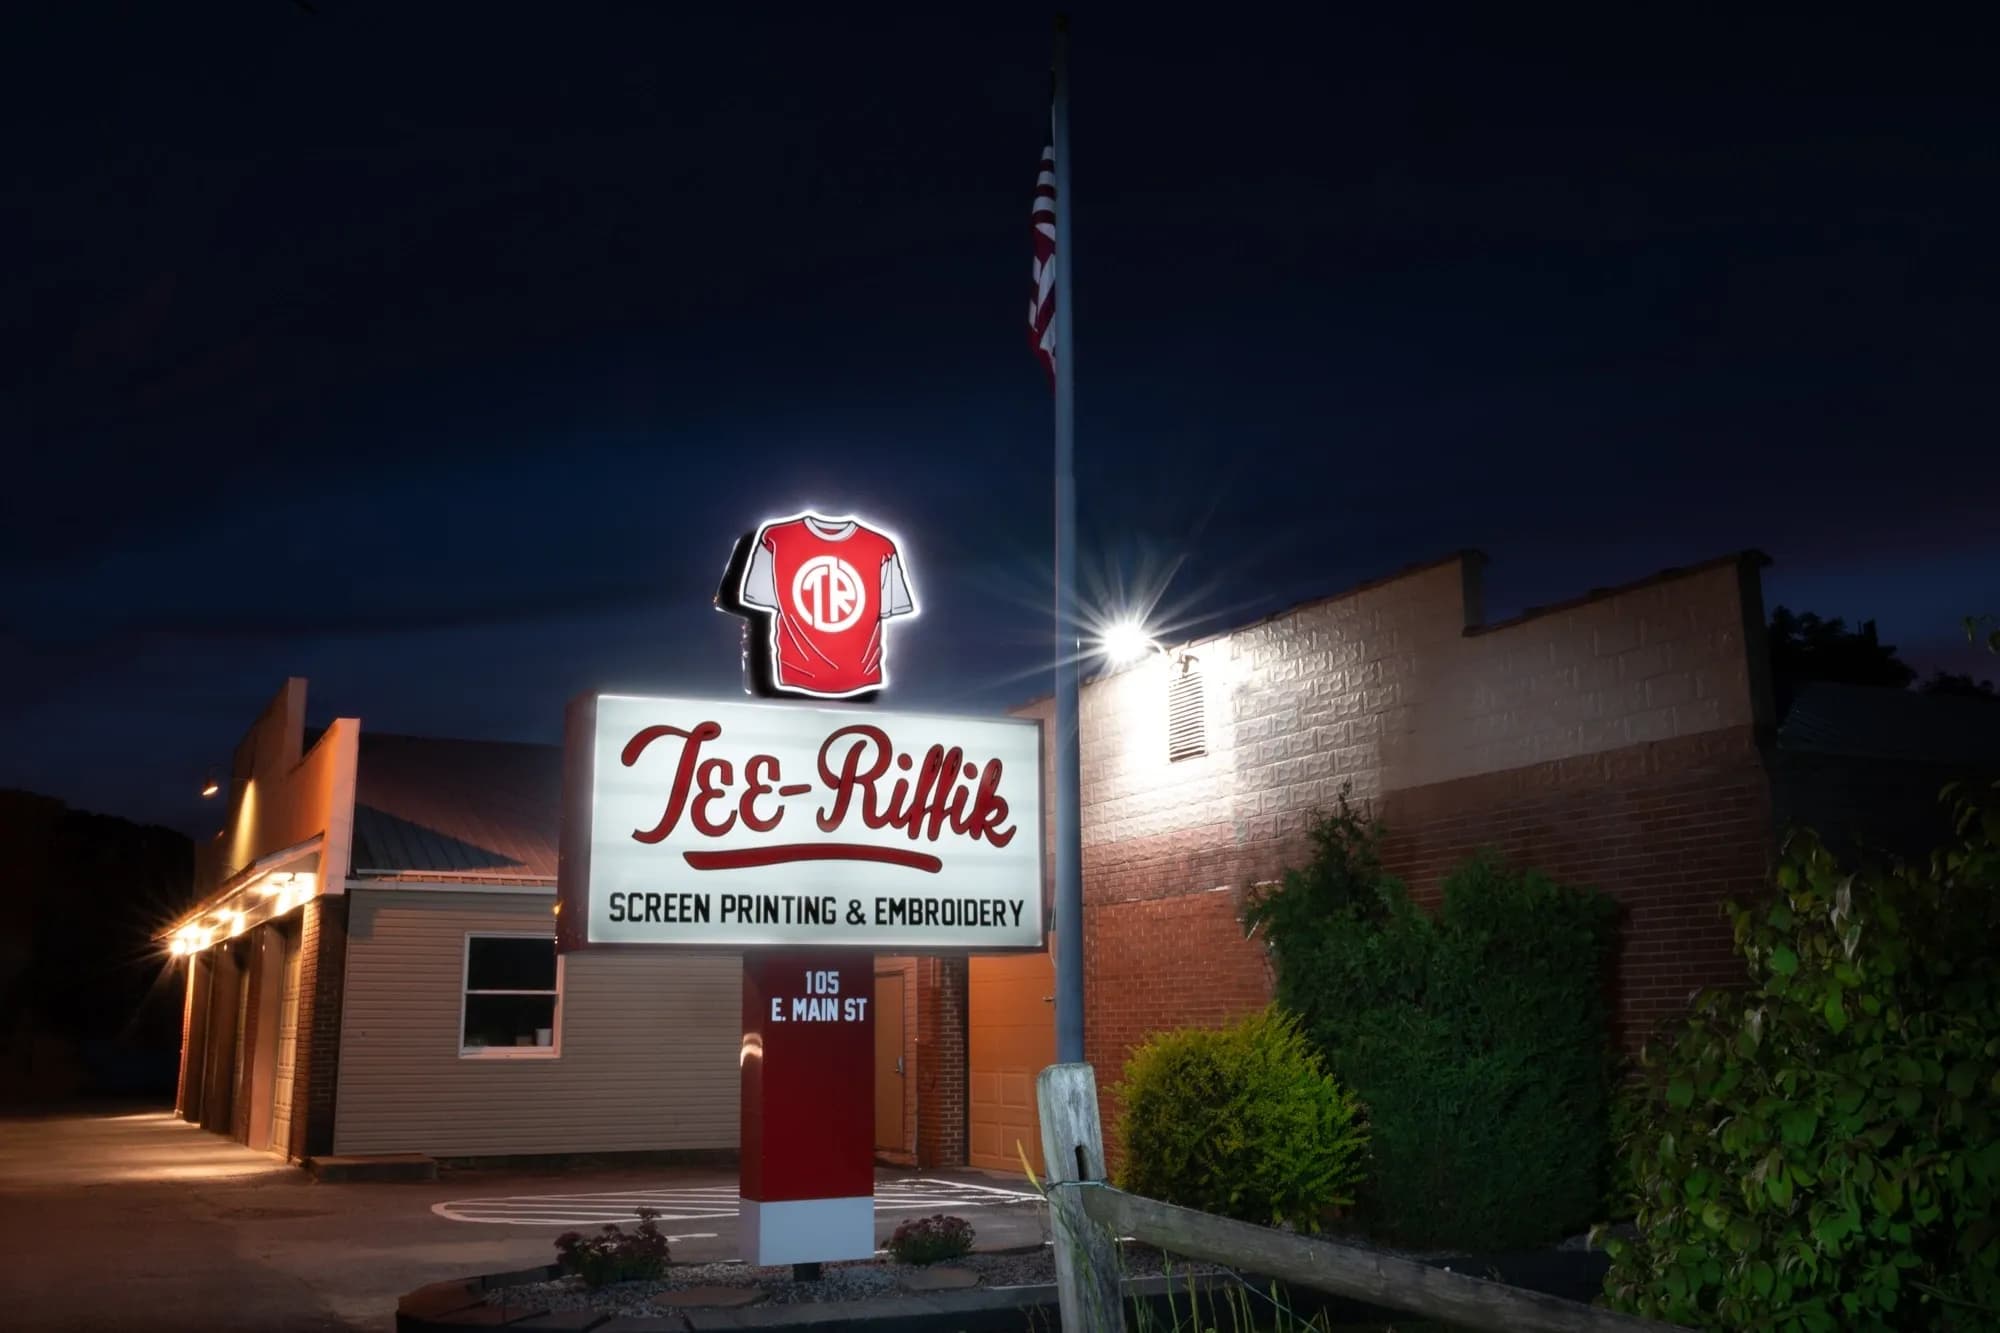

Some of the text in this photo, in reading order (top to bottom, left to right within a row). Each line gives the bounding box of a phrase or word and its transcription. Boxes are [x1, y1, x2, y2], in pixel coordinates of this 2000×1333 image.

[608, 892, 1025, 928] SCREEN PRINTING & EMBROIDERY
[805, 970, 840, 995] 105
[771, 997, 868, 1022] E. MAIN ST
